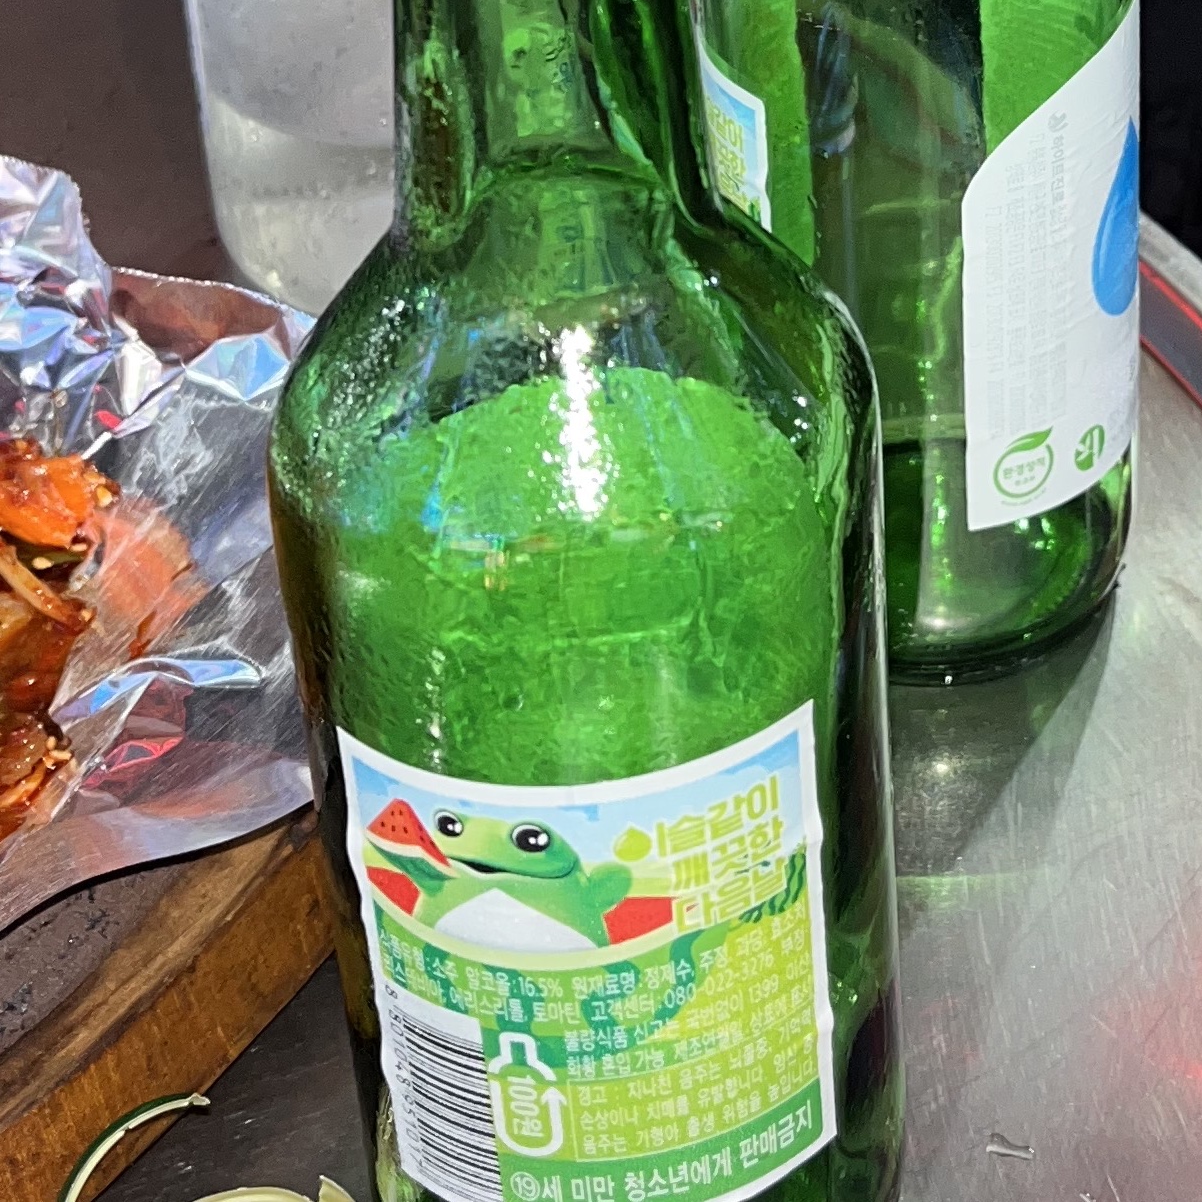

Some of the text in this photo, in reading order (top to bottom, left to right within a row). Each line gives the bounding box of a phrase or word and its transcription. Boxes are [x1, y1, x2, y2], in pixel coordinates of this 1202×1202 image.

[613, 774, 780, 862] 이슬같이
[673, 817, 785, 893] 깨끗한
[674, 855, 787, 934] 다음날
[564, 1025, 628, 1053] 불량식품
[634, 1017, 681, 1045] 신고는
[686, 990, 743, 1029] 국번없이
[507, 1074, 543, 1138] 100원
[627, 1073, 673, 1100] 지나친
[678, 1060, 721, 1090] 음주는
[580, 1105, 639, 1131] 손상이나
[646, 1094, 690, 1120] 치매를
[582, 1133, 628, 1155] 음주는
[635, 1121, 679, 1148] 기형아
[571, 1175, 615, 1202] 미만
[624, 1146, 732, 1202] 청소년에게
[739, 1099, 812, 1169] 판매금지
